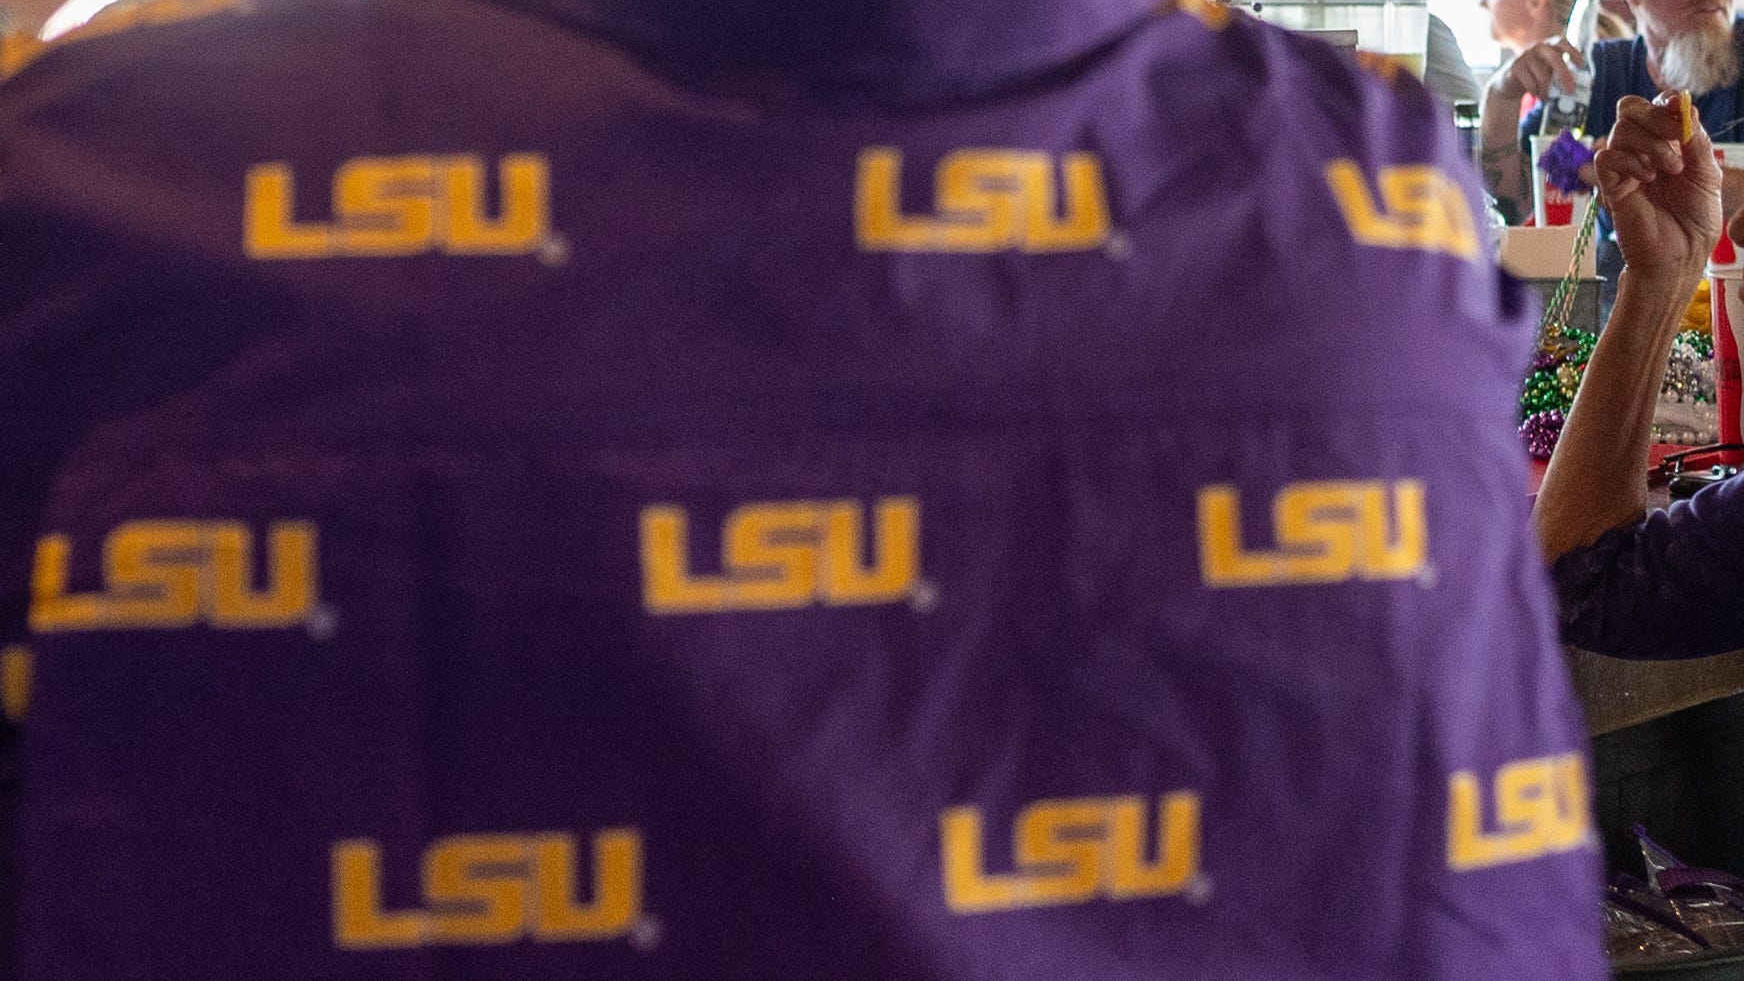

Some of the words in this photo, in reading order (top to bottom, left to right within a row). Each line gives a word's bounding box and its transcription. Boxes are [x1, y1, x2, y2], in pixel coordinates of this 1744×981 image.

[242, 153, 552, 260] LSU
[856, 146, 1112, 255] LSU
[27, 518, 320, 634] LSU
[638, 495, 923, 617] LSU
[1195, 478, 1428, 589] LSU
[330, 825, 644, 951] LSU
[938, 789, 1202, 916] LSU
